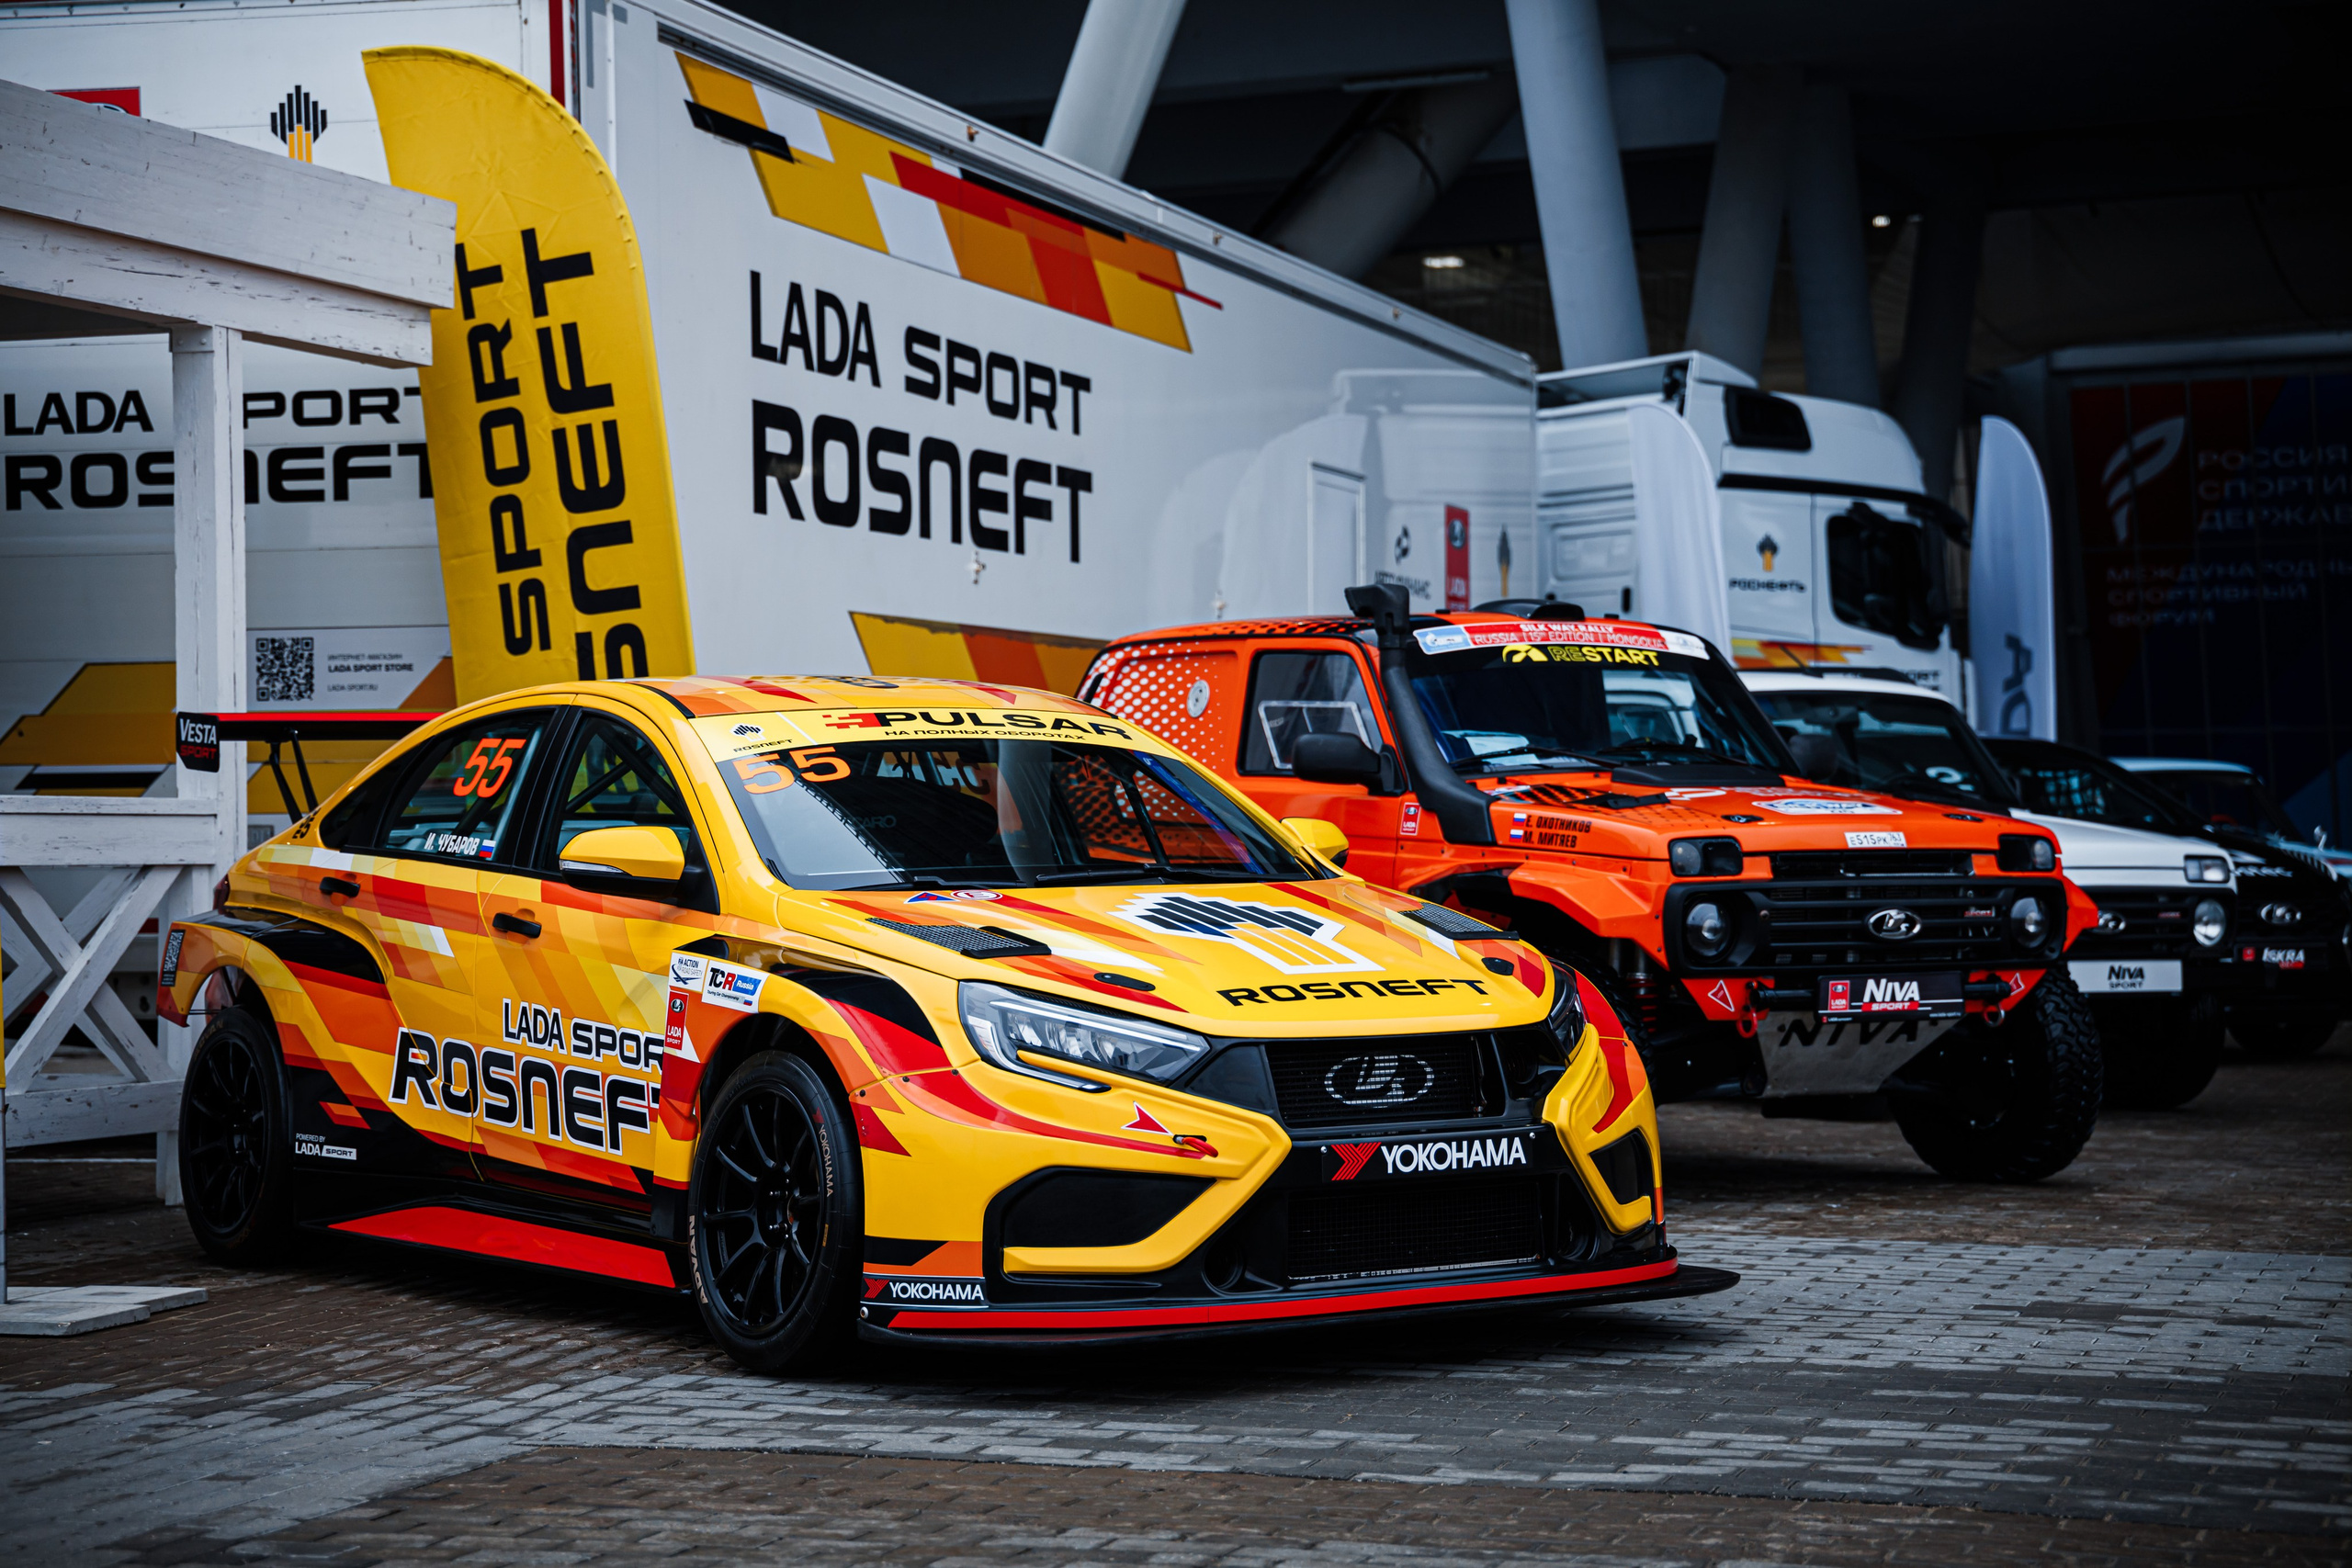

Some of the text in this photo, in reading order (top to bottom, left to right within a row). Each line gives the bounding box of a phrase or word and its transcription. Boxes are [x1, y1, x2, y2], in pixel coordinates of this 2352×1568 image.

[750, 270, 1091, 435] LADA SPORT
[4, 387, 420, 435] LADA POR
[455, 243, 551, 656] SPORT
[521, 228, 649, 681] SNEFT
[5, 442, 434, 511] ROSEFT
[752, 399, 1092, 563] ROSNEFT
[2198, 473, 2352, 502] СПОРТИ
[2198, 502, 2352, 533] ДЕРЖАВ
[1474, 633, 1519, 645] RUSSIA
[1548, 632, 1593, 643] EDITION
[1608, 634, 1664, 649] MONGOLIA
[1520, 624, 1614, 634] SILK WAY RALLY
[328, 663, 413, 672] LADA SPORT STORE
[1547, 646, 1659, 667] RESTART
[179, 718, 217, 745] VESTA
[876, 712, 1132, 741] PULSAR
[994, 730, 1086, 740] ОБОРОТАХ
[179, 745, 217, 761] SPORT
[733, 739, 792, 753] ROSNEFT
[453, 738, 527, 798] 55
[732, 746, 852, 795] 55
[1536, 816, 1592, 833] ОХОТНИКОВ
[437, 833, 481, 856] ЧУБАРОВ
[1537, 831, 1577, 848] МИТЯЕВ
[684, 958, 699, 968] ACTION
[2262, 947, 2305, 963] ISKRA
[708, 967, 754, 991] TCR Russia
[2108, 965, 2145, 981] NIVA
[1217, 978, 1490, 1007] ROSNEFT
[1863, 978, 1920, 1002] NIVA
[1871, 1002, 1911, 1010] SPORT
[503, 998, 664, 1074] LADA SPOR
[666, 1037, 681, 1045] SPORT
[667, 1025, 682, 1038] LADA
[296, 1133, 319, 1142] POWERED
[295, 1142, 354, 1157] LADA SPORT
[818, 1124, 834, 1198] YOKOHAMA
[1380, 1137, 1528, 1175] YOKOHAMA
[689, 1214, 708, 1304] ADVAN
[889, 1282, 984, 1301] YOKOHAMA
